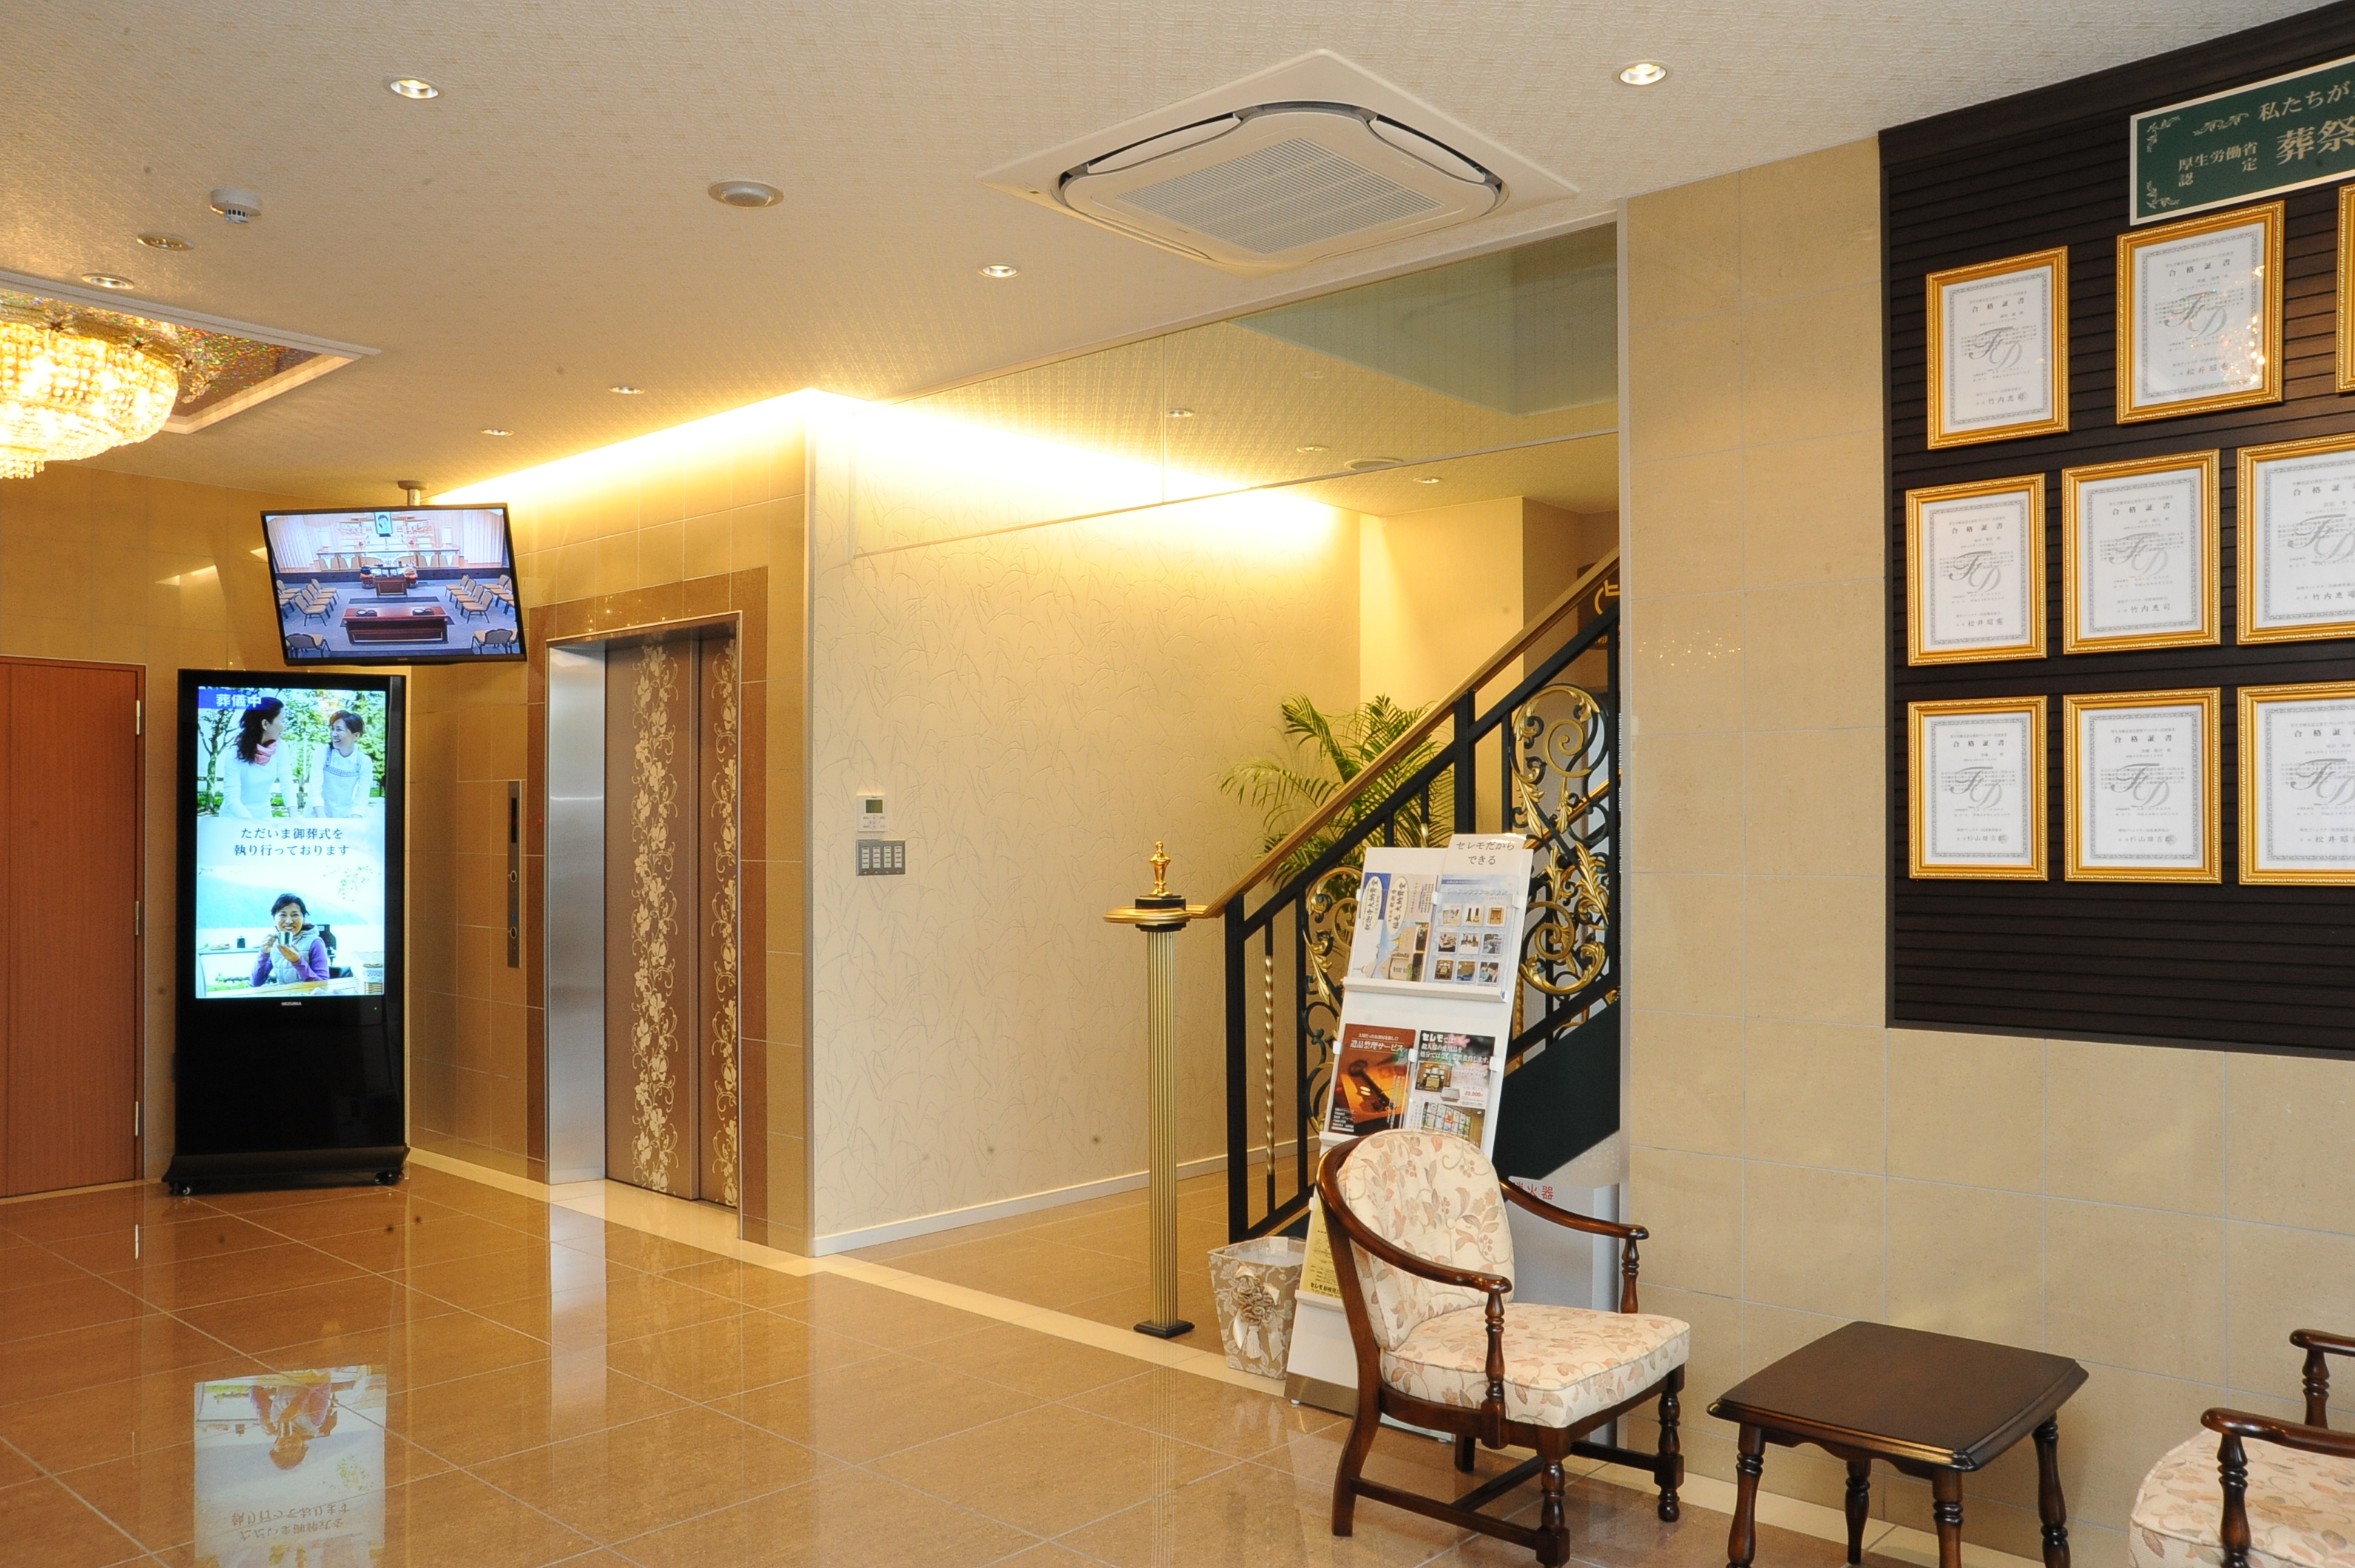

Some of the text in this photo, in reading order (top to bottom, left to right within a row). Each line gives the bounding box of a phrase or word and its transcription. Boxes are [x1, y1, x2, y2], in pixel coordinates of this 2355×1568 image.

[2258, 81, 2355, 121] 私たちが
[2276, 116, 2355, 165] 葬祭
[2178, 142, 2257, 172] 厚生労働省
[2169, 259, 2231, 277] 合格証書
[1972, 297, 2025, 313] 合格証書
[2112, 502, 2171, 516] 合格証書
[1952, 523, 2003, 535] 合格証書
[215, 693, 262, 709] 葬儀中
[1953, 740, 2004, 748] 合格証書
[2114, 735, 2172, 743] 合格証書
[240, 828, 343, 840] ただいま御葬式を
[233, 844, 350, 856] 執り行っております
[1456, 840, 1515, 851] セレモだから
[1467, 855, 1496, 865] できる
[1350, 1040, 1404, 1052] 遺品整理サービス
